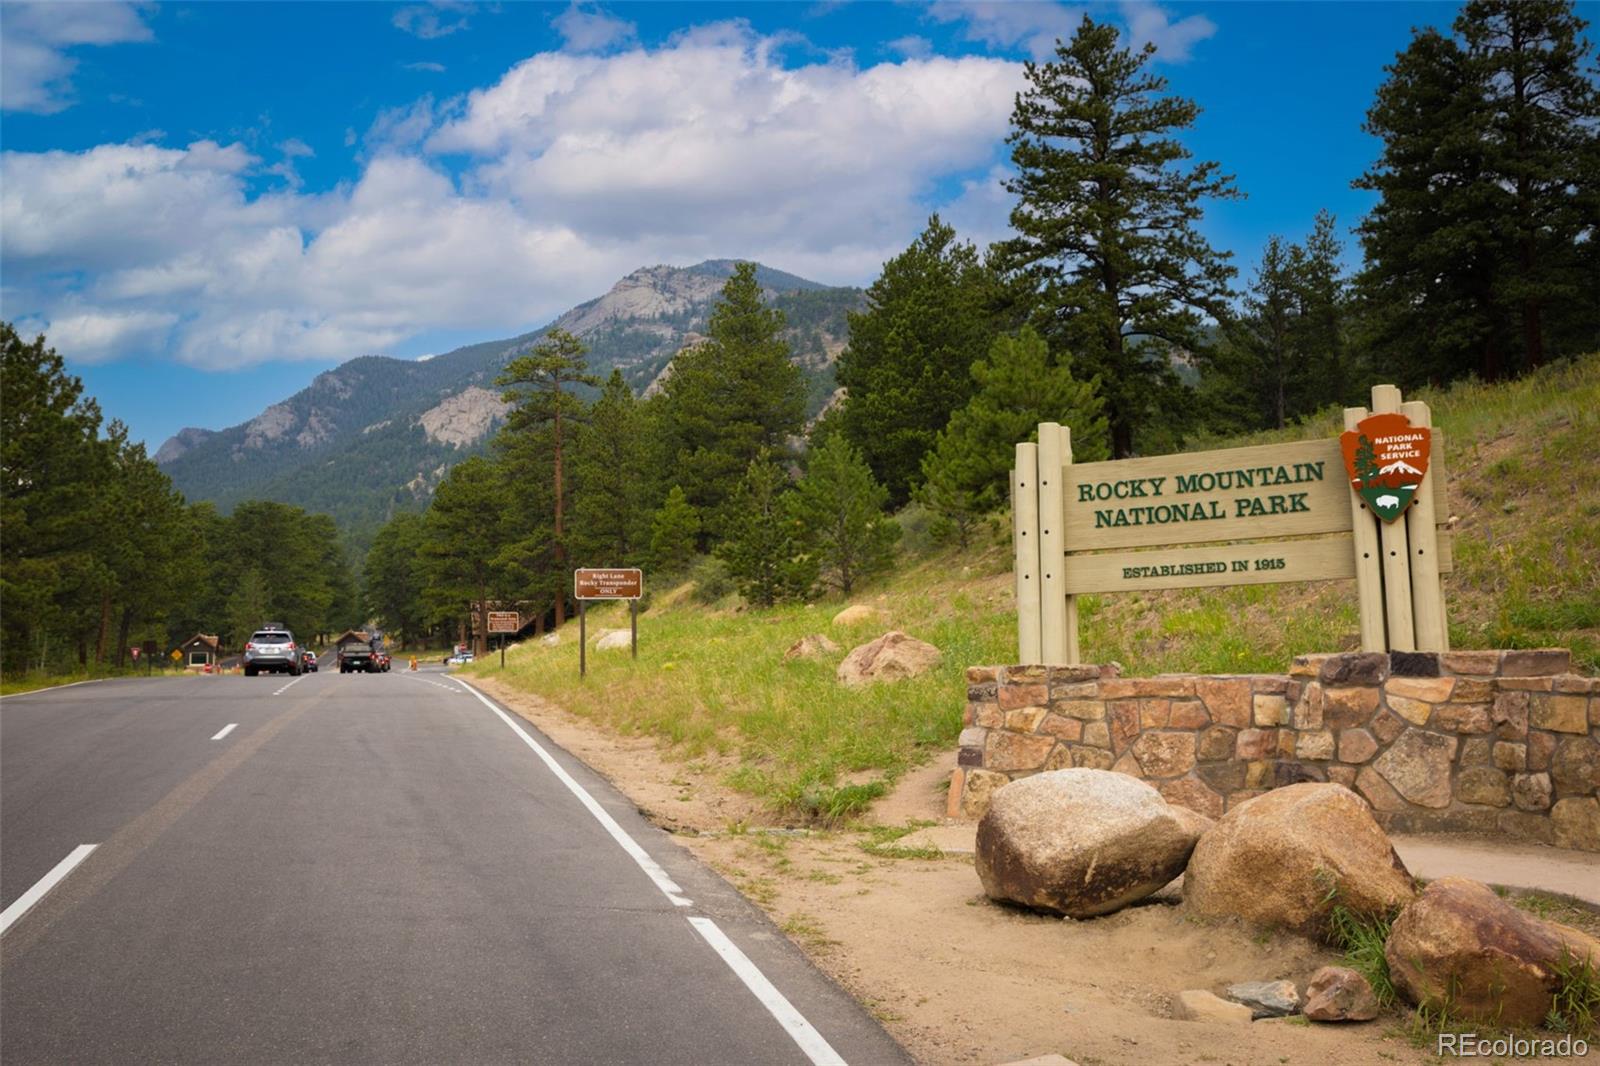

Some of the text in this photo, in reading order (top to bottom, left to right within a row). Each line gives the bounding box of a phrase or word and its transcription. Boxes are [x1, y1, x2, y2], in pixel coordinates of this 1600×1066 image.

[1374, 433, 1424, 444] NATIONAL
[1380, 450, 1420, 460] SERVICE
[1387, 443, 1412, 451] PARK
[1077, 461, 1325, 502] ROCKY MOUNTAIN
[1095, 493, 1310, 528] NATIONAL PARK
[1122, 558, 1286, 579] ESTABLISHED IN 1915
